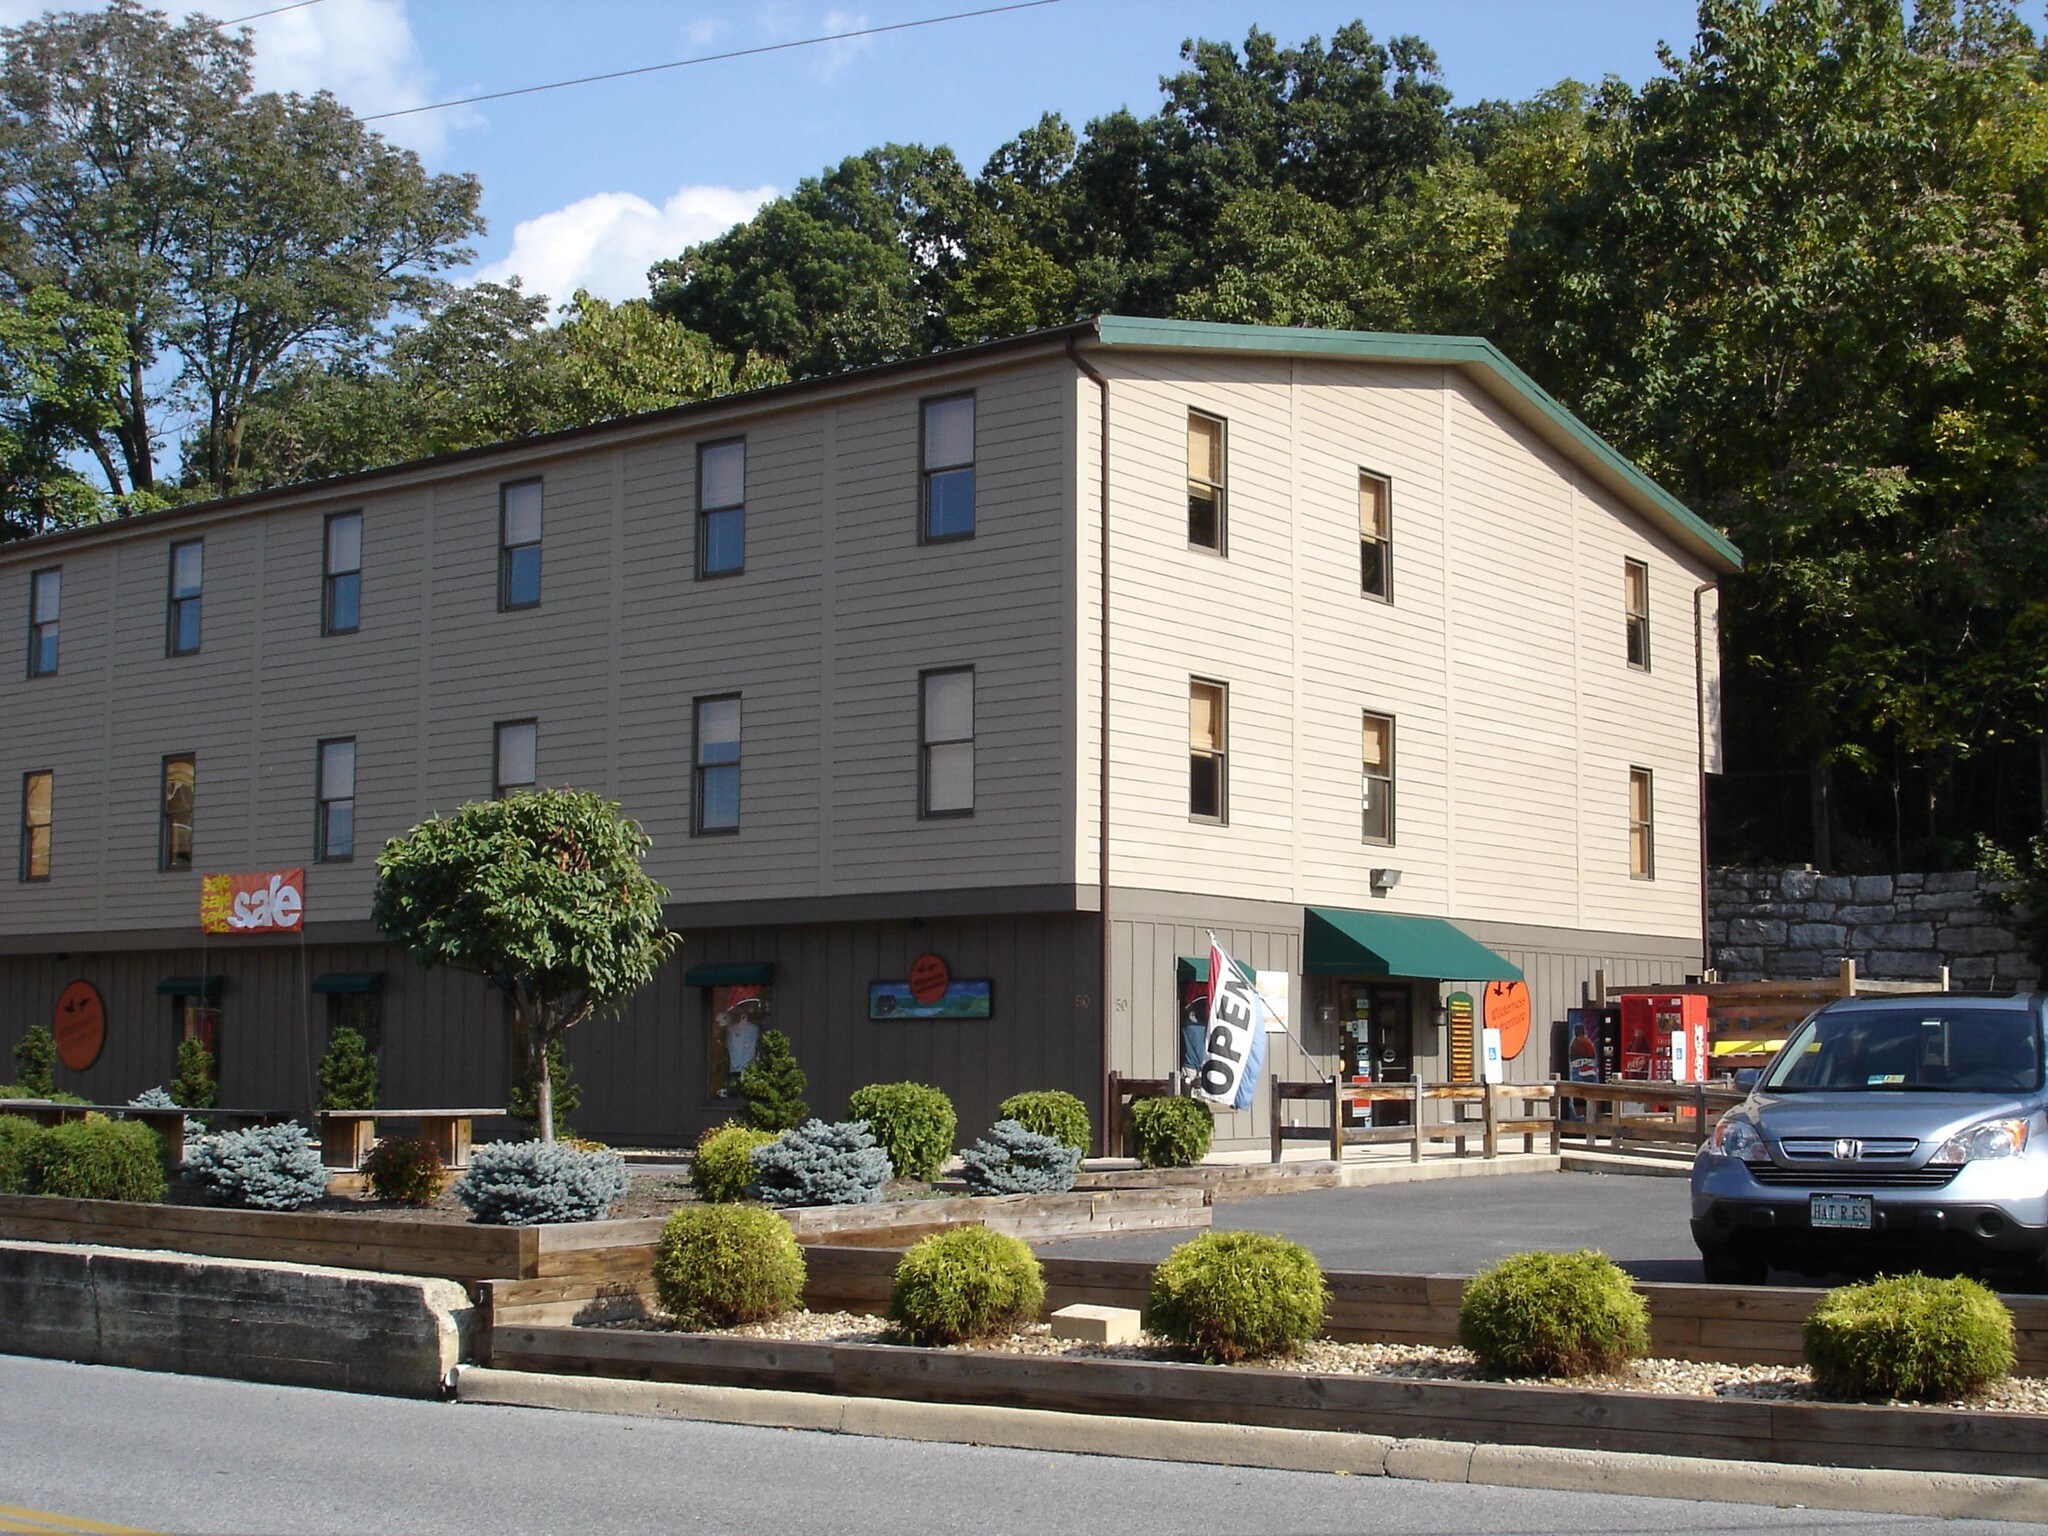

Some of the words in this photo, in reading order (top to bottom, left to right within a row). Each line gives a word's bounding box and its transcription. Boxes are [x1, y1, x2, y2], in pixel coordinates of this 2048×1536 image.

[227, 874, 302, 928] sale
[1115, 998, 1128, 1012] 50
[1201, 967, 1251, 1095] OPEN
[1814, 1204, 1835, 1220] HAT
